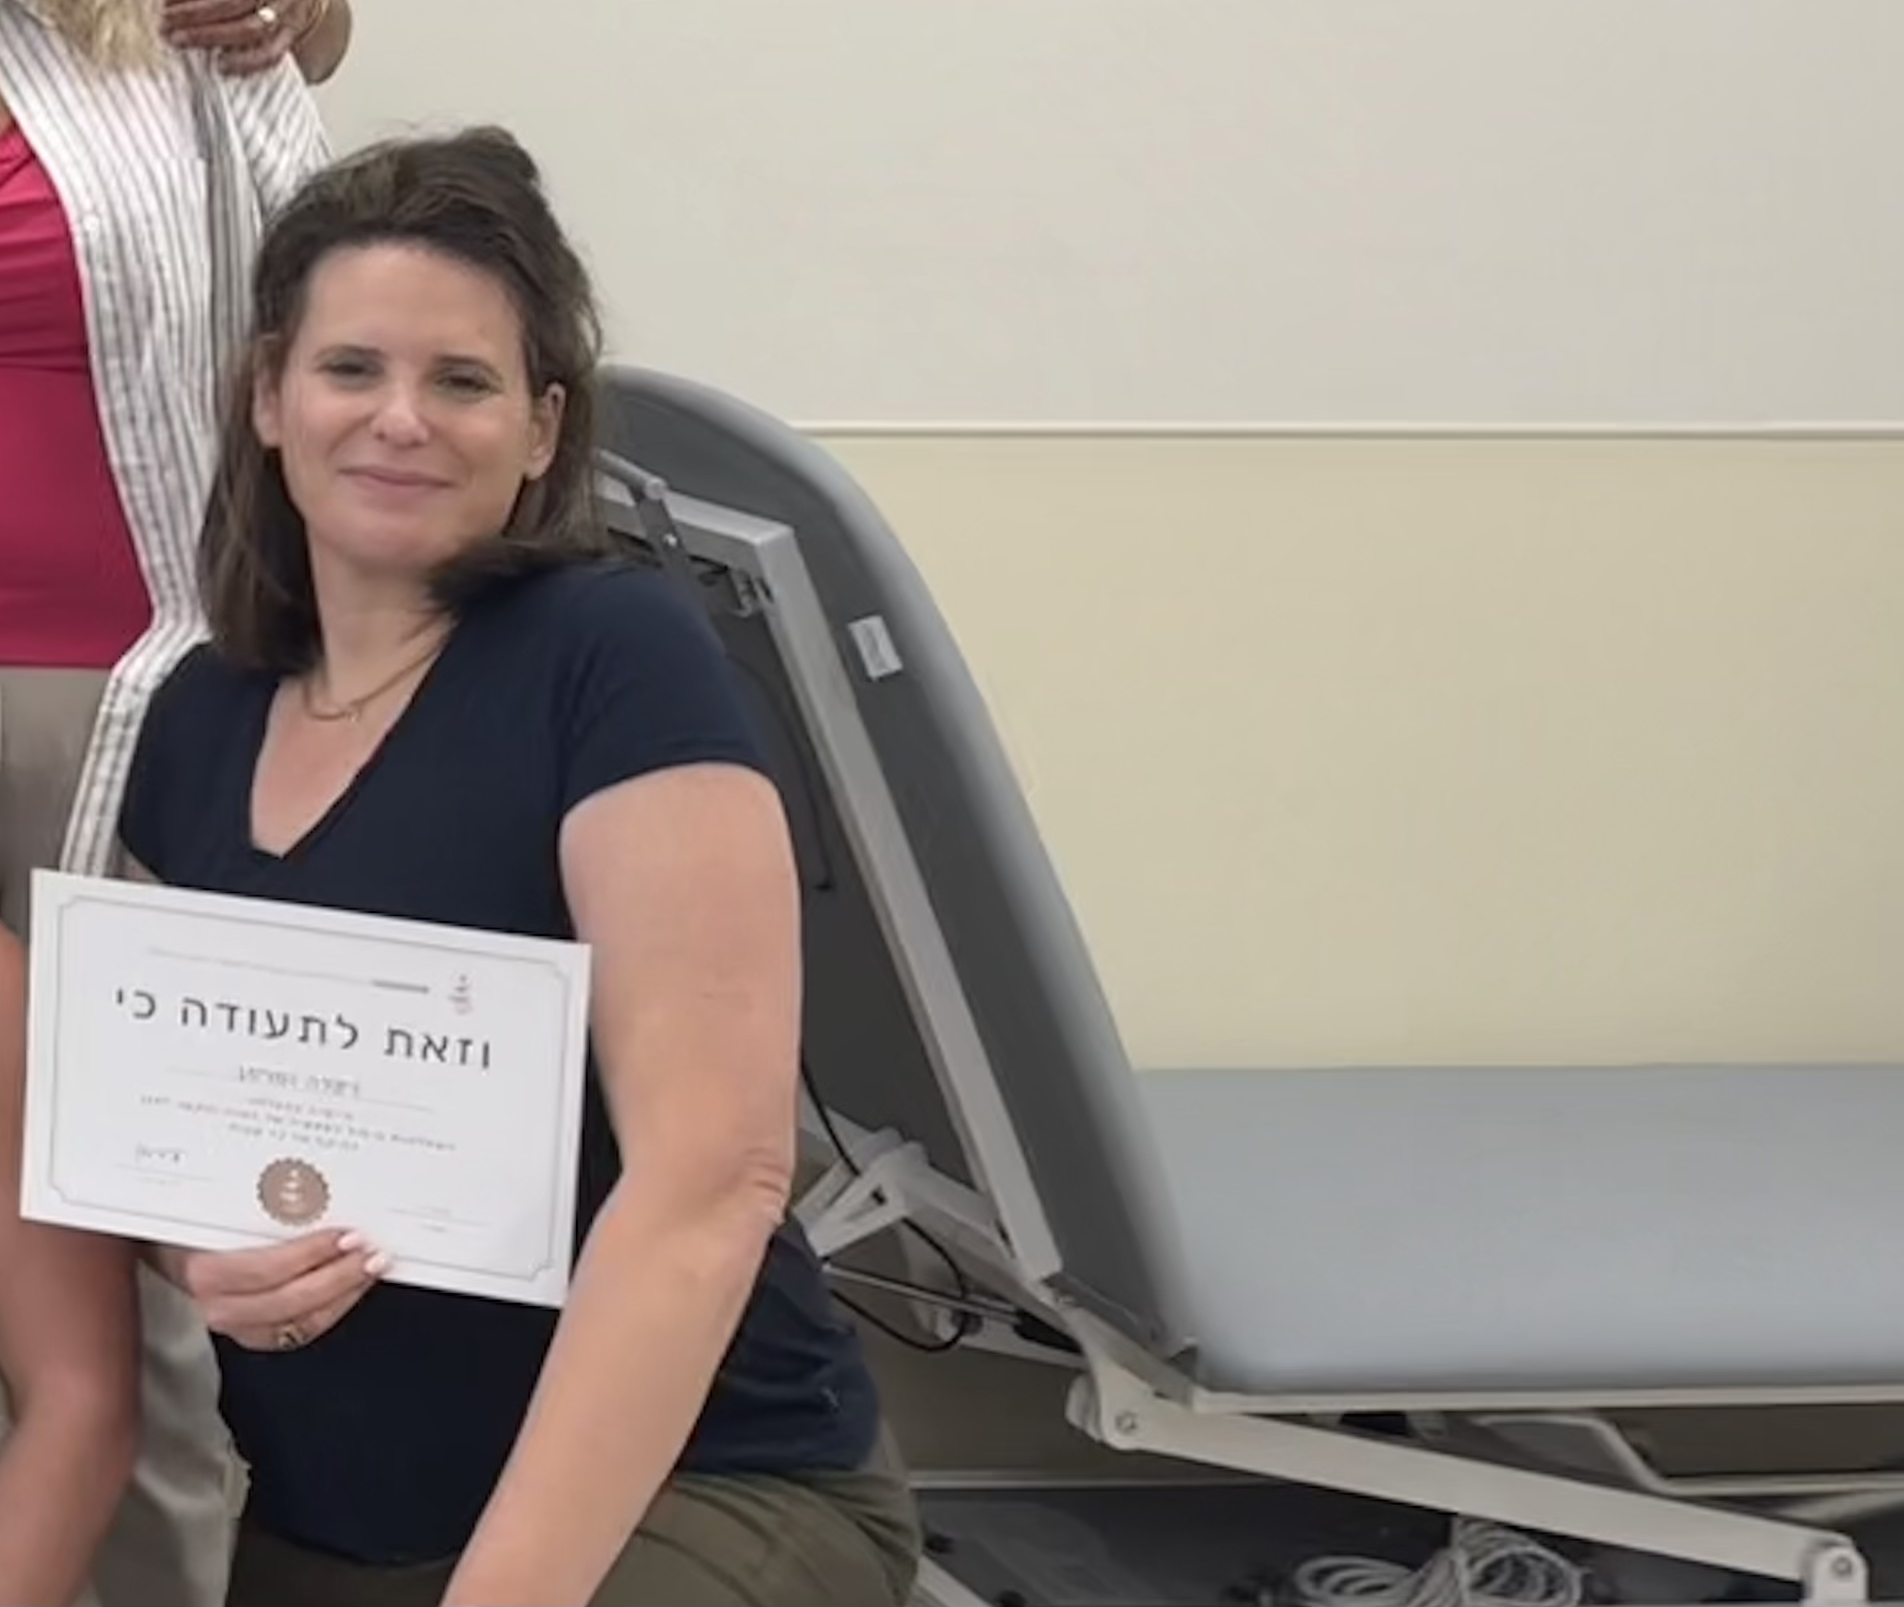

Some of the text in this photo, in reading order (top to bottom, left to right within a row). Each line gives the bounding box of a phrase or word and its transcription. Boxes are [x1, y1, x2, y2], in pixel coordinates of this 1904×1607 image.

[114, 985, 492, 1071] וזאת לתעודה כי
